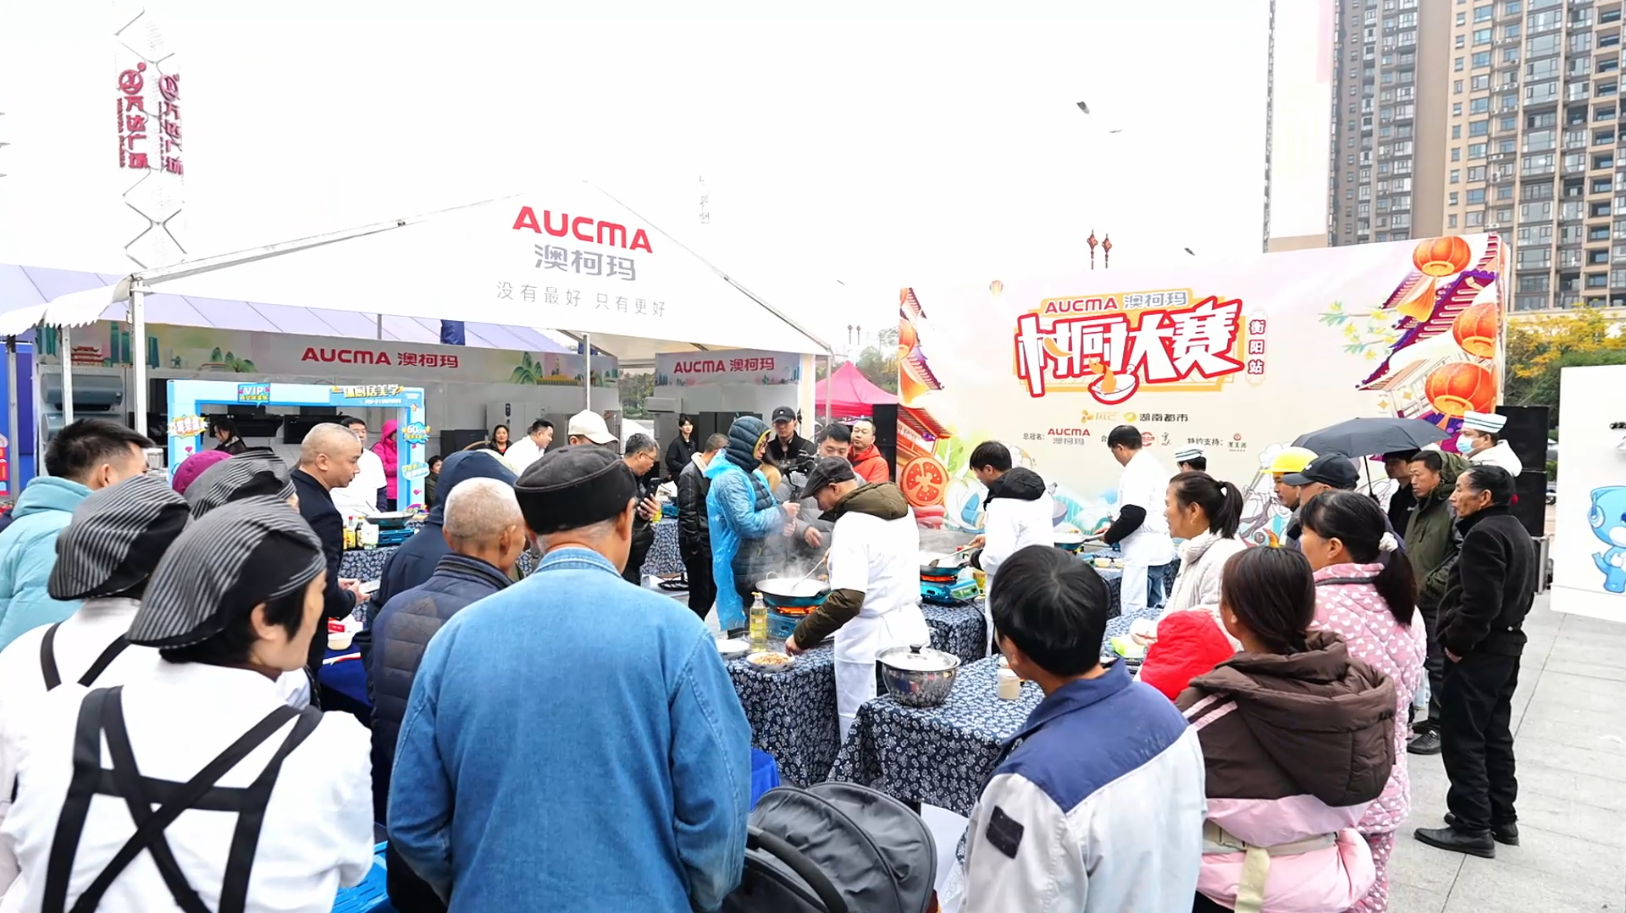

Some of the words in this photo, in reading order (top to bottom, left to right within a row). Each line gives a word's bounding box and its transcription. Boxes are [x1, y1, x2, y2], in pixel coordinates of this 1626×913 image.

[124, 96, 148, 169] 万达广场
[513, 206, 653, 253] AUCMA
[534, 244, 636, 281] 澳柯玛
[497, 281, 581, 307] 没有最好
[596, 293, 665, 317] 只有更好
[1045, 298, 1118, 314] AUCMA
[1124, 291, 1187, 309] 澳柯玛
[301, 347, 392, 365] AUCMA
[397, 352, 459, 368] 澳柯玛
[1015, 296, 1244, 397] 村厨大赛
[1248, 319, 1266, 375] 衡阳站
[673, 360, 726, 373] AUCMA
[730, 357, 775, 372] 澳柯玛
[244, 386, 264, 395] VIP
[1139, 413, 1189, 423] 湖南都市
[1047, 428, 1091, 437] AUCMA
[1187, 437, 1223, 447] 特约支持：
